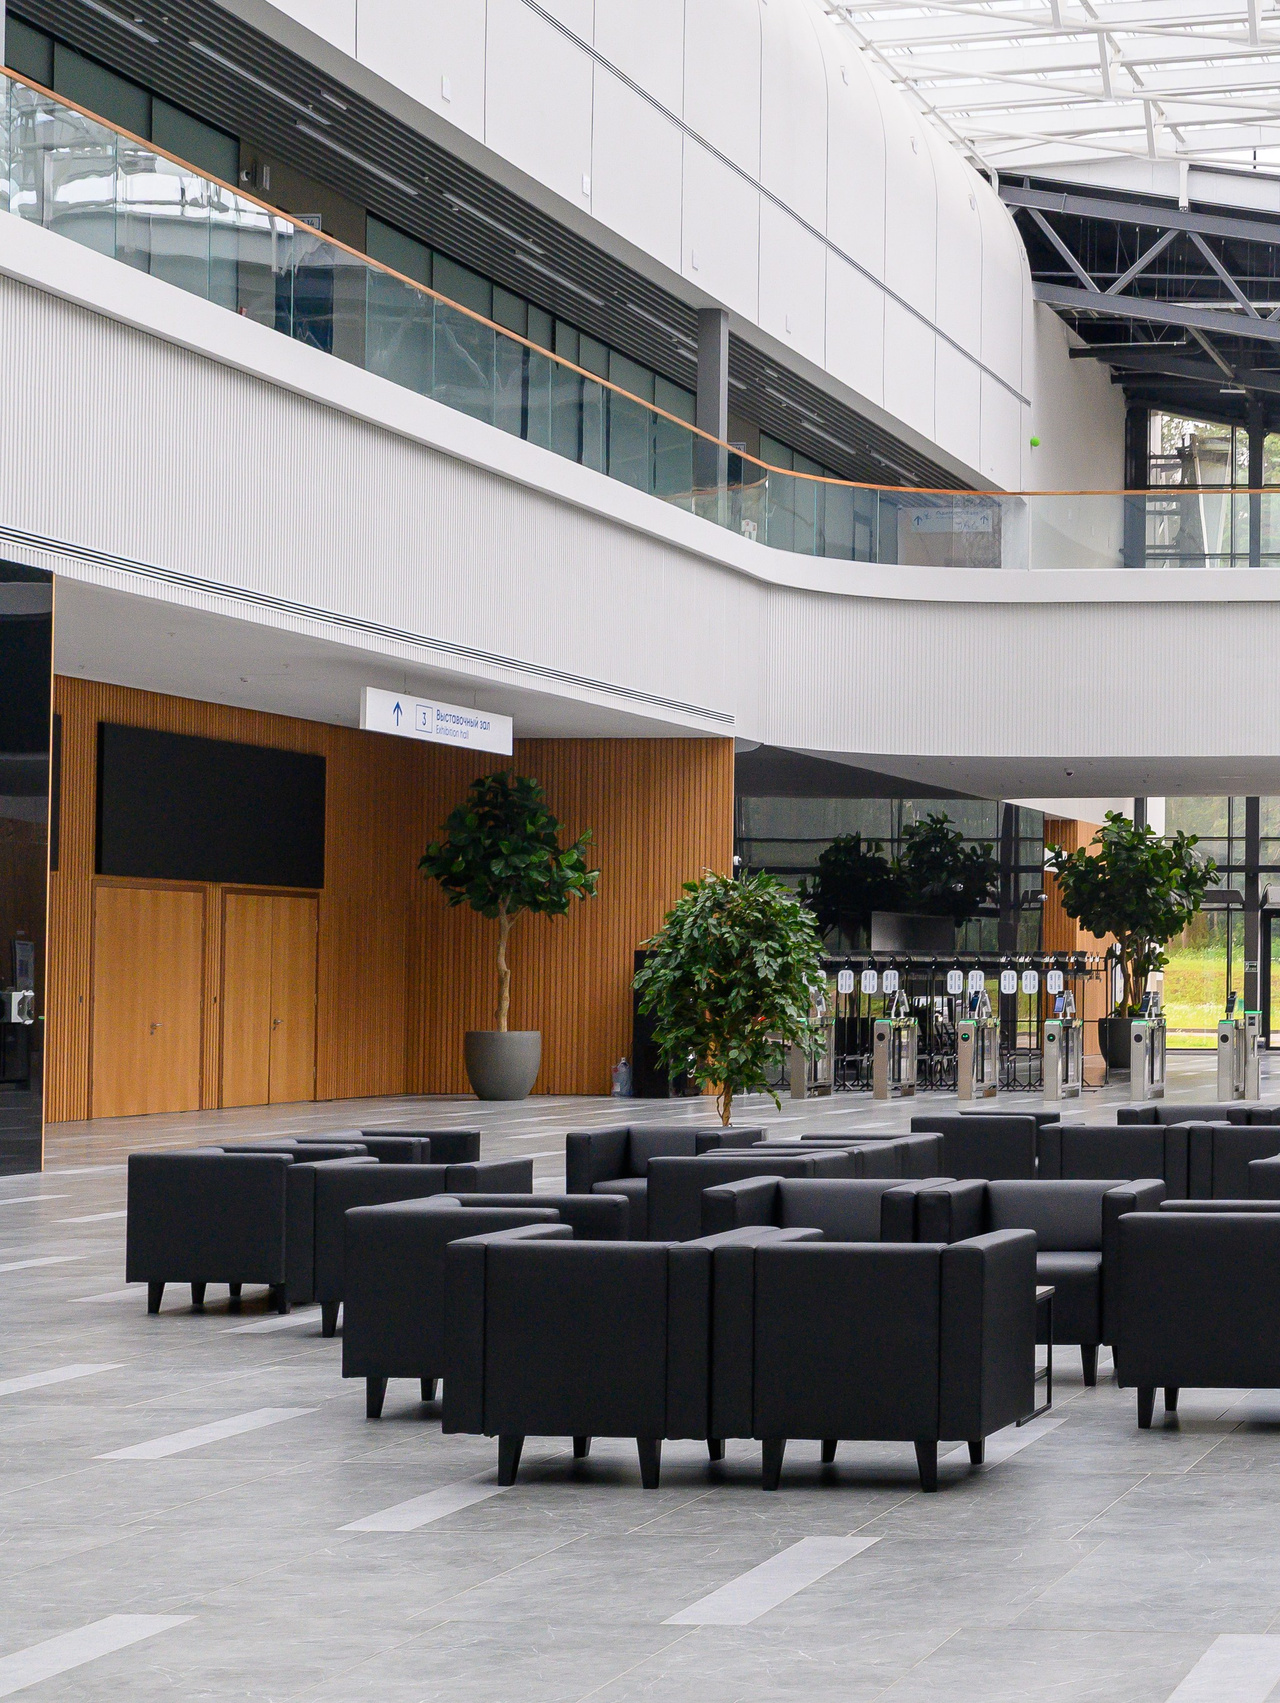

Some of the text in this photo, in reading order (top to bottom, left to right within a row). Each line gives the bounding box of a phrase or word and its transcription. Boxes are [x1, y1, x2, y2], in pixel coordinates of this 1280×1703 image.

[422, 712, 427, 726] 3
[436, 709, 491, 731] Выставочный зал
[436, 725, 470, 740] Exhibition hall
